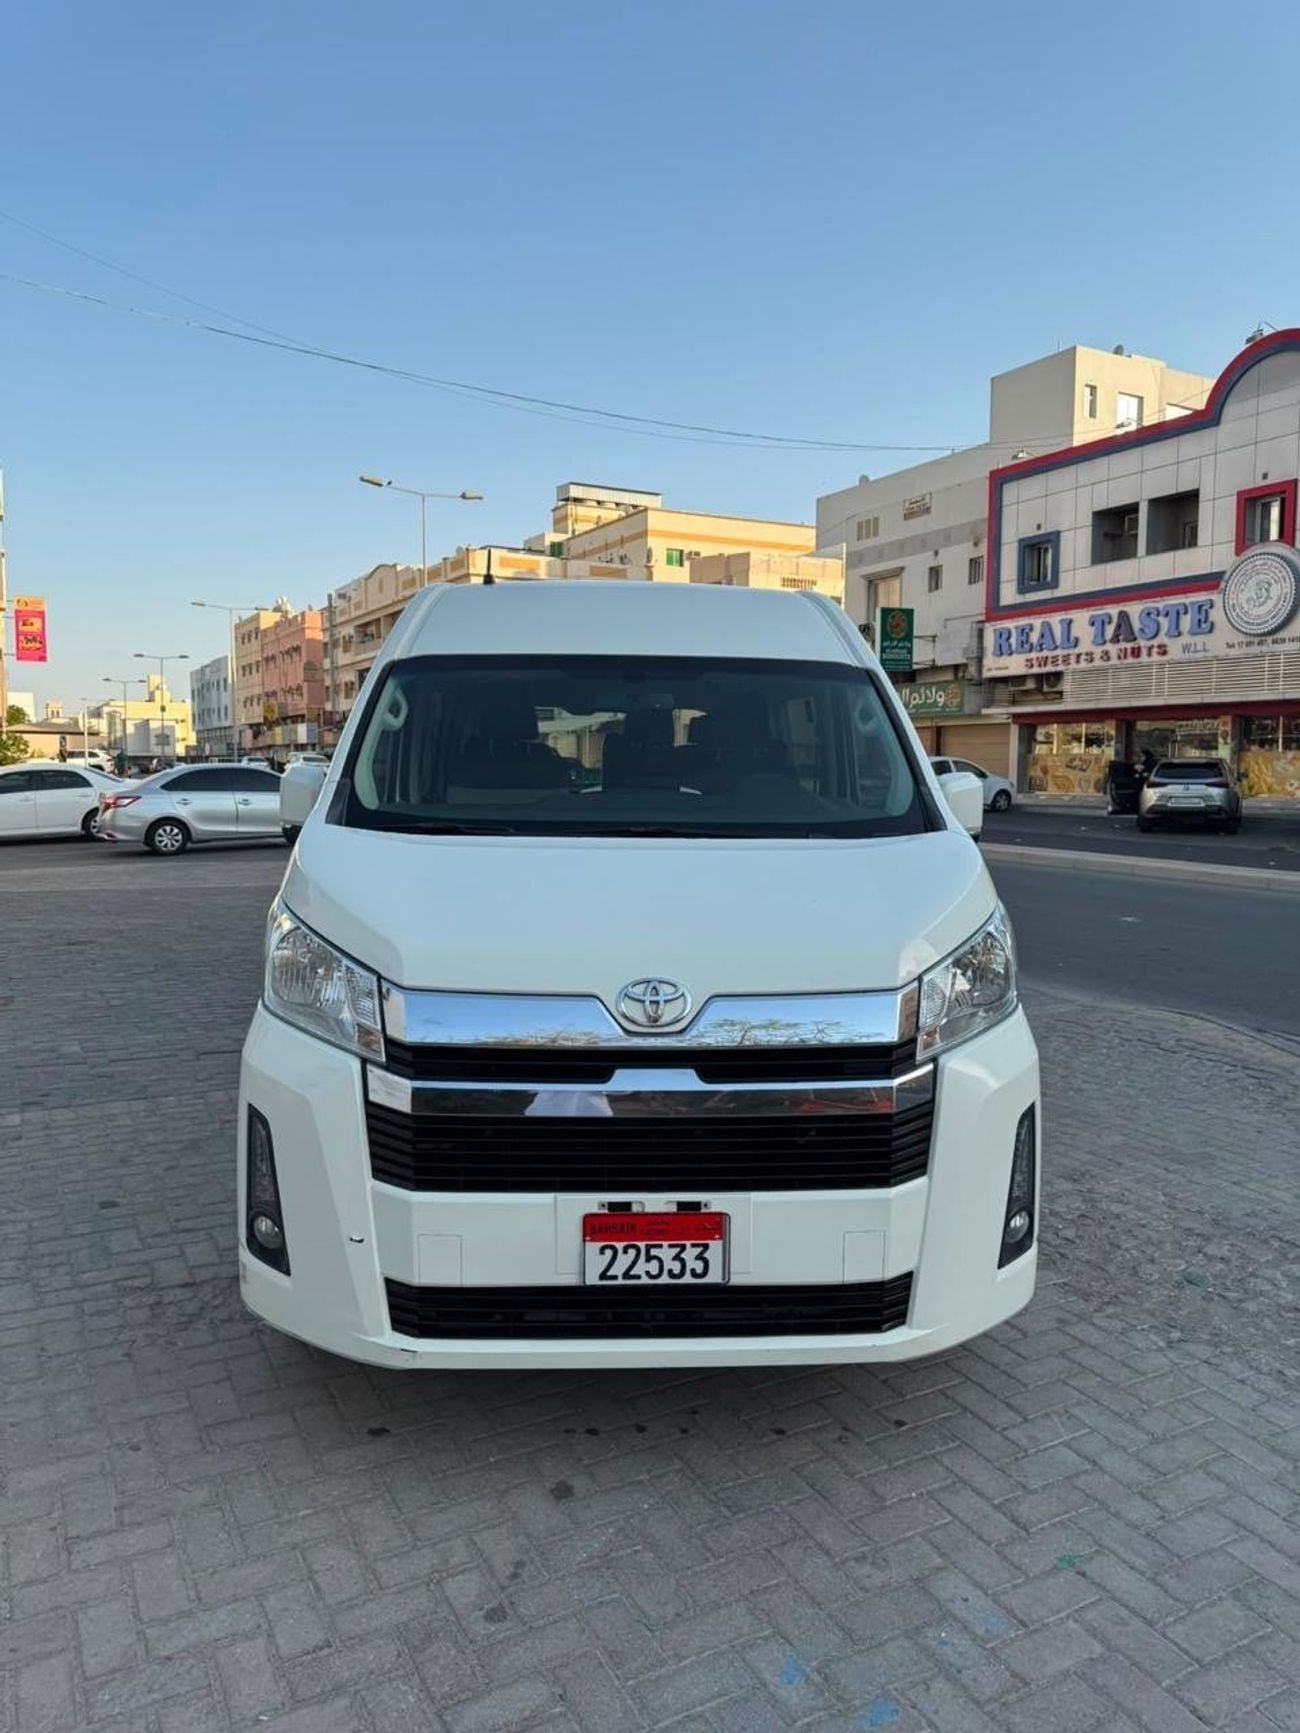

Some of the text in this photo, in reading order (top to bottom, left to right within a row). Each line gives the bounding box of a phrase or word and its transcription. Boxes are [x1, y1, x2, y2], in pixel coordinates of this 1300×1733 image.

[992, 598, 1215, 657] REAL TASTE
[1024, 643, 1169, 670] SWEETS & NUTS
[909, 686, 945, 708] ولائم
[590, 1222, 636, 1235] BAHRAIN
[598, 1243, 710, 1281] 22533
